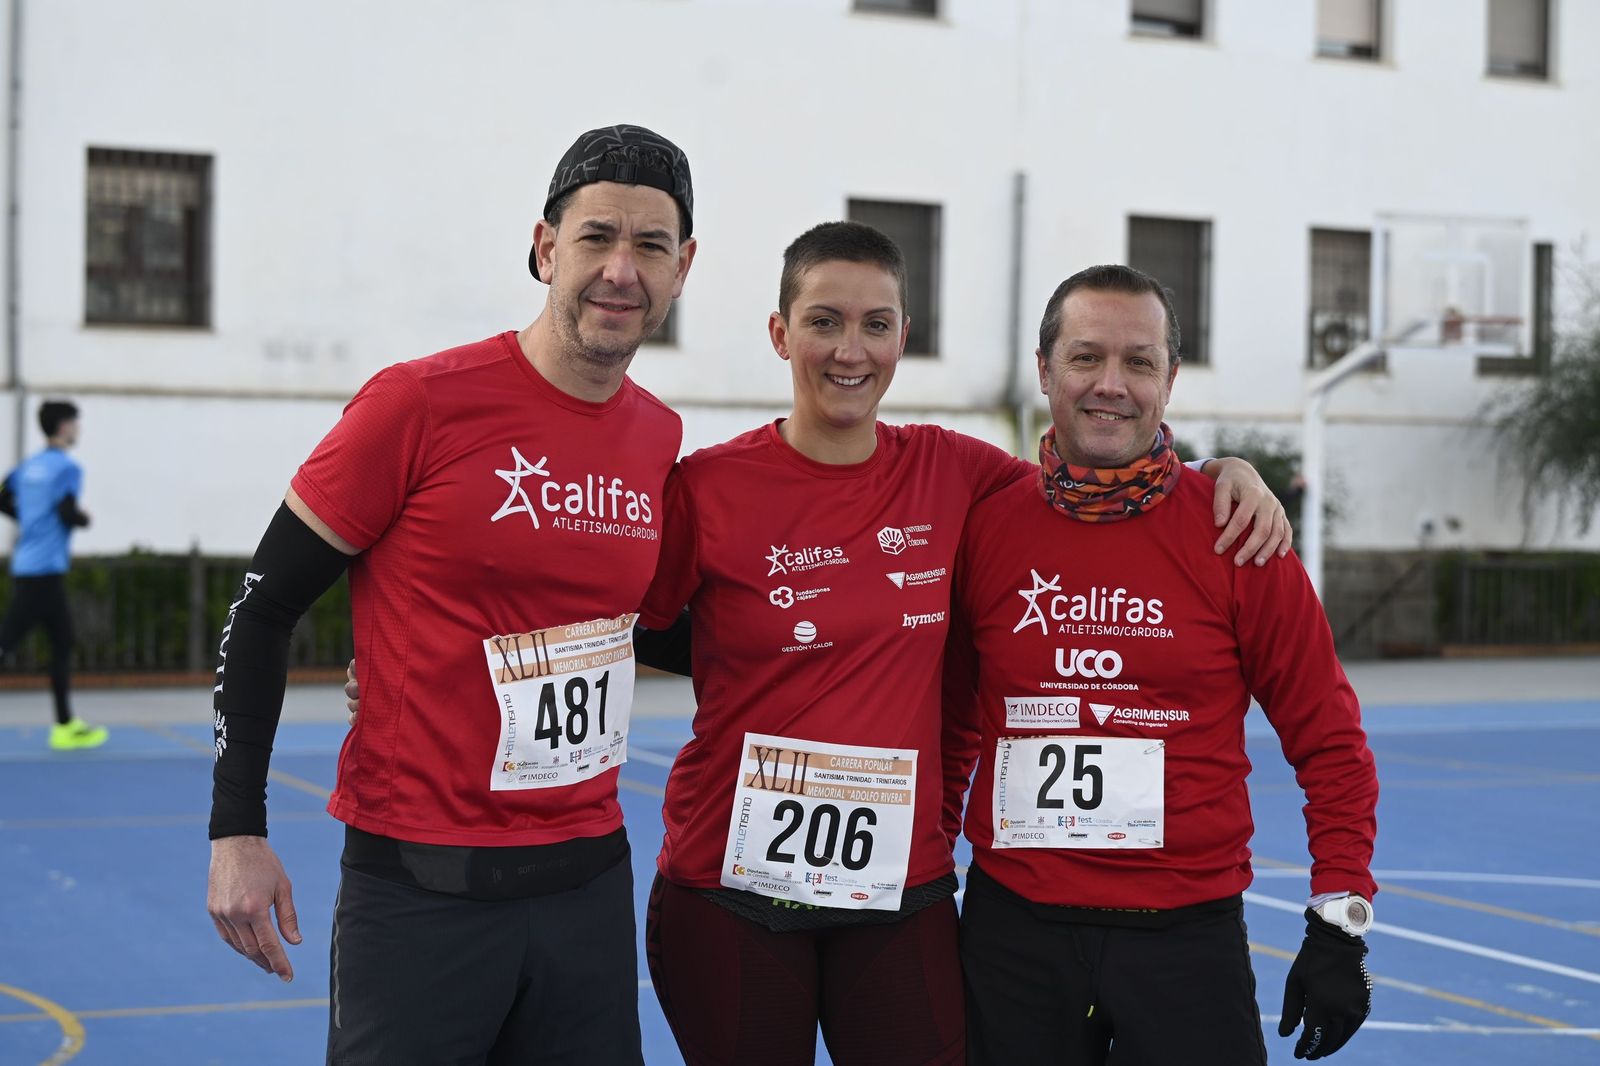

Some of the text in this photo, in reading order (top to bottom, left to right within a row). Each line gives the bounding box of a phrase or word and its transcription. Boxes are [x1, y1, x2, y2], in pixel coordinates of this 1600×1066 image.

[541, 473, 653, 524] califas
[784, 546, 844, 566] califas
[1050, 587, 1164, 624] califas
[565, 623, 596, 638] CARRERA
[554, 643, 583, 655] SANTISIMA
[782, 644, 808, 653] GESTIÓN
[813, 641, 833, 649] CALOR
[493, 632, 553, 683] XLII
[1055, 648, 1123, 679] UCO
[553, 658, 588, 673] MEMORIAL
[1040, 682, 1089, 690] UNIVERSIDAD
[1102, 681, 1139, 691] CÓRDOBA
[534, 670, 610, 750] 481
[1020, 702, 1078, 716] IMDECO
[1113, 708, 1190, 721] AGRIMENSUR
[830, 756, 863, 769] CARRERA
[747, 746, 811, 795] XLII
[1036, 743, 1103, 810] 25
[814, 772, 845, 781] SANTISIMA
[846, 775, 872, 784] TRINIDAD
[876, 778, 908, 786] TRINITARIOS
[807, 785, 845, 799] MEMORIAL
[766, 799, 878, 870] 206
